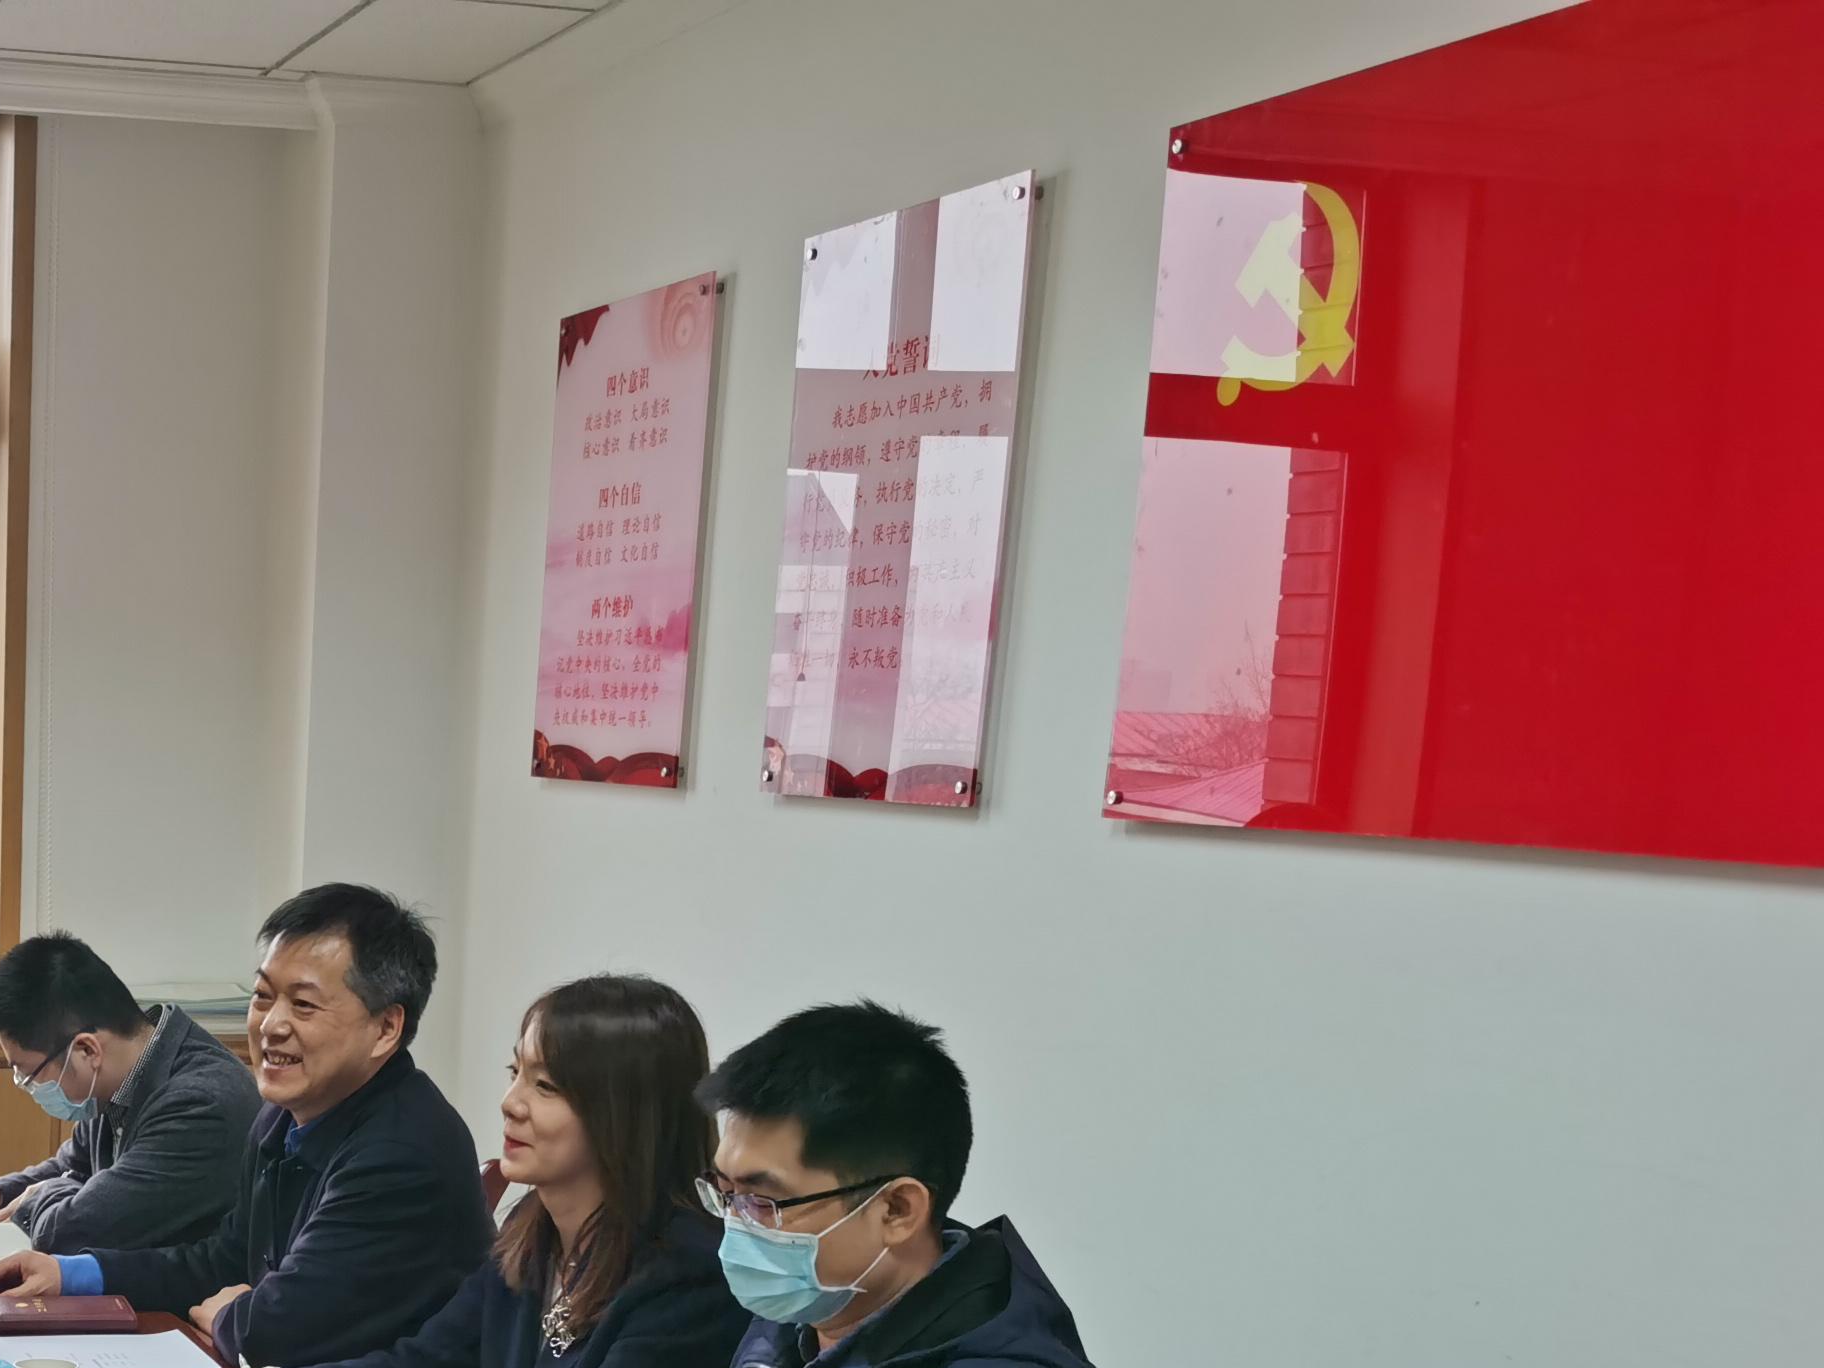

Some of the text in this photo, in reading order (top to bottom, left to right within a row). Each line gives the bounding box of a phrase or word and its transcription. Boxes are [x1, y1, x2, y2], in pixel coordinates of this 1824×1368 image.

[606, 367, 649, 397] 四个意识
[599, 482, 642, 508] 四个自信
[592, 595, 634, 619] 两个维护
